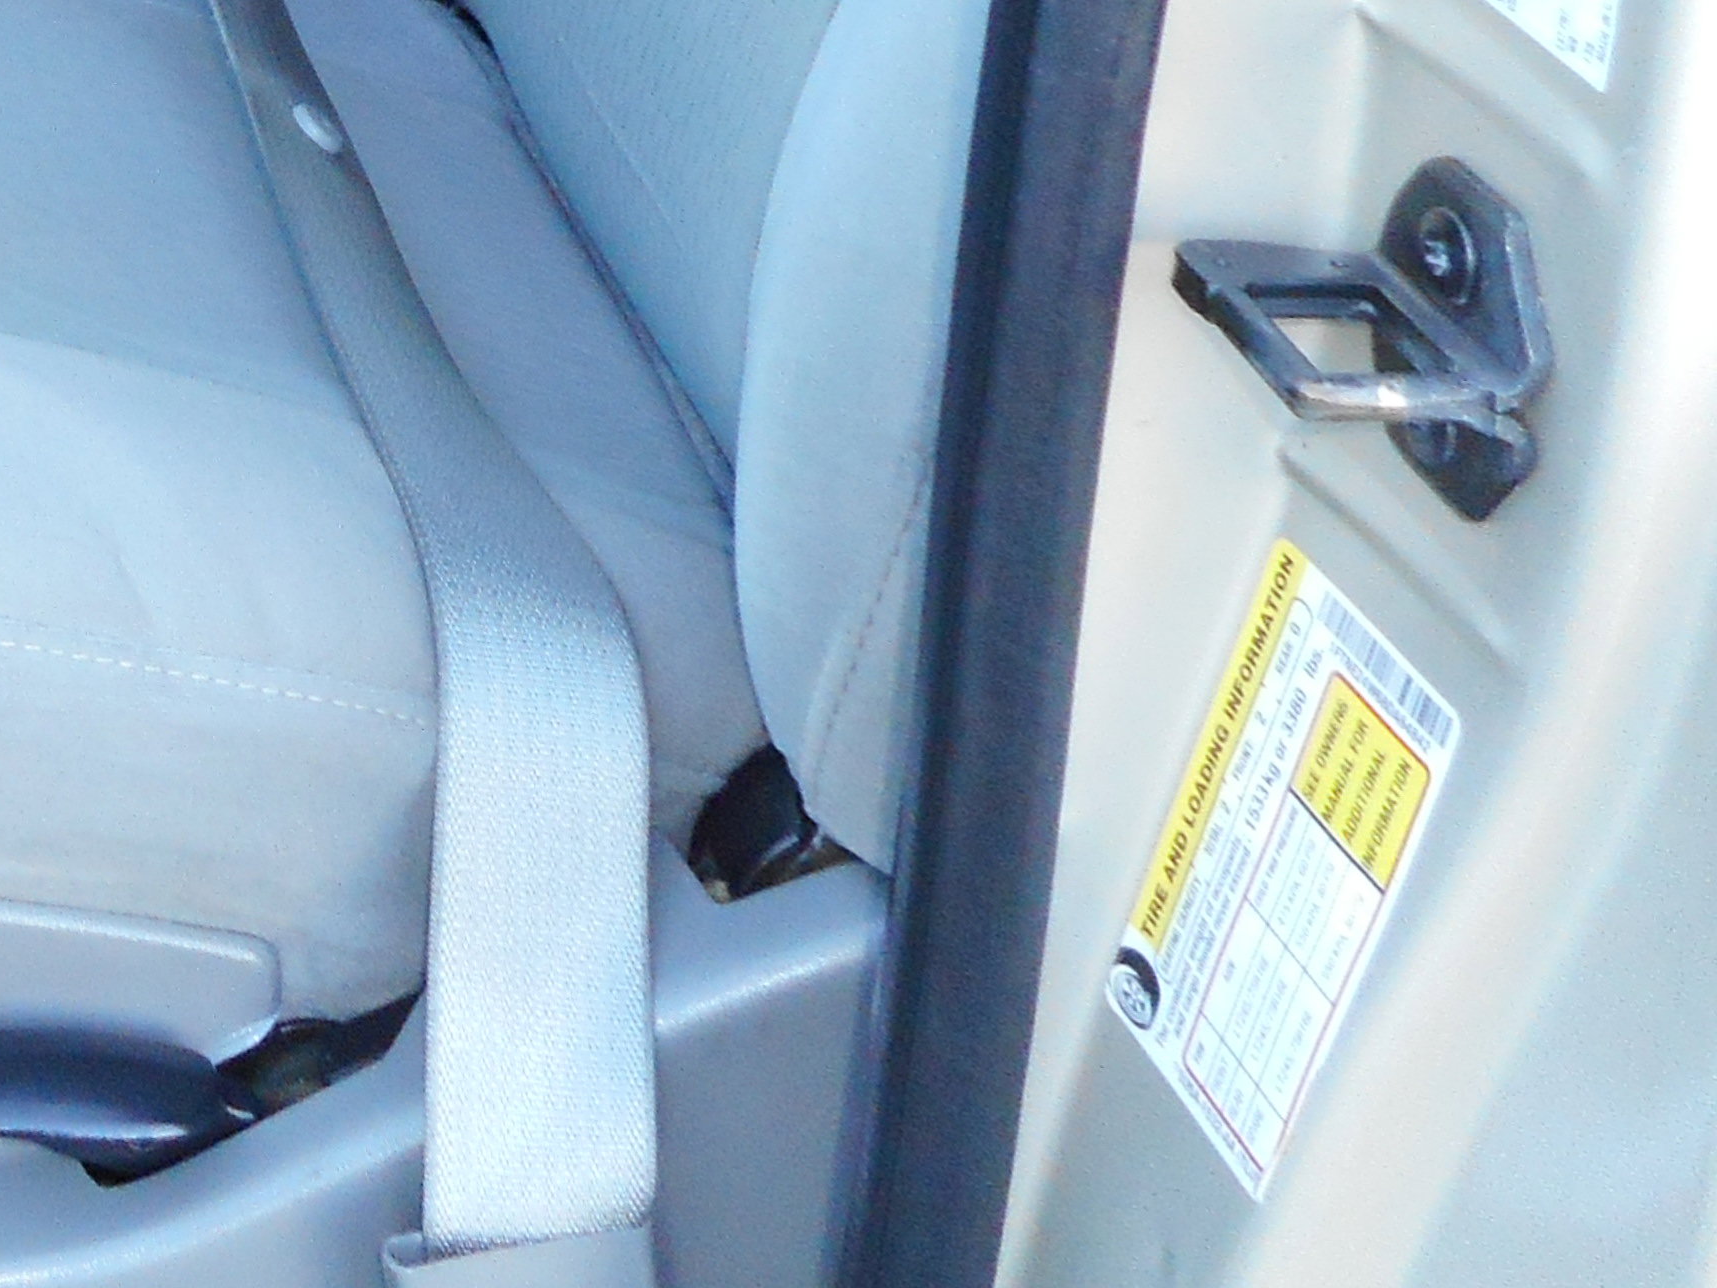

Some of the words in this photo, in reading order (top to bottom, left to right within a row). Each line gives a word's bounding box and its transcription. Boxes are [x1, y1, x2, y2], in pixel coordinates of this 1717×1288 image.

[1140, 883, 1170, 940] TIRE
[1163, 831, 1190, 884] AND
[1186, 724, 1231, 829] LOADING
[1221, 551, 1295, 721] INFORMATION
[1272, 736, 1288, 763] or
[1278, 683, 1308, 741] 3380
[1300, 768, 1320, 803] SEE
[1319, 754, 1354, 825] MANUAL
[1348, 716, 1369, 755] FOR
[1340, 746, 1387, 845] ADDITIONAL
[1358, 755, 1414, 872] INFORMATION
